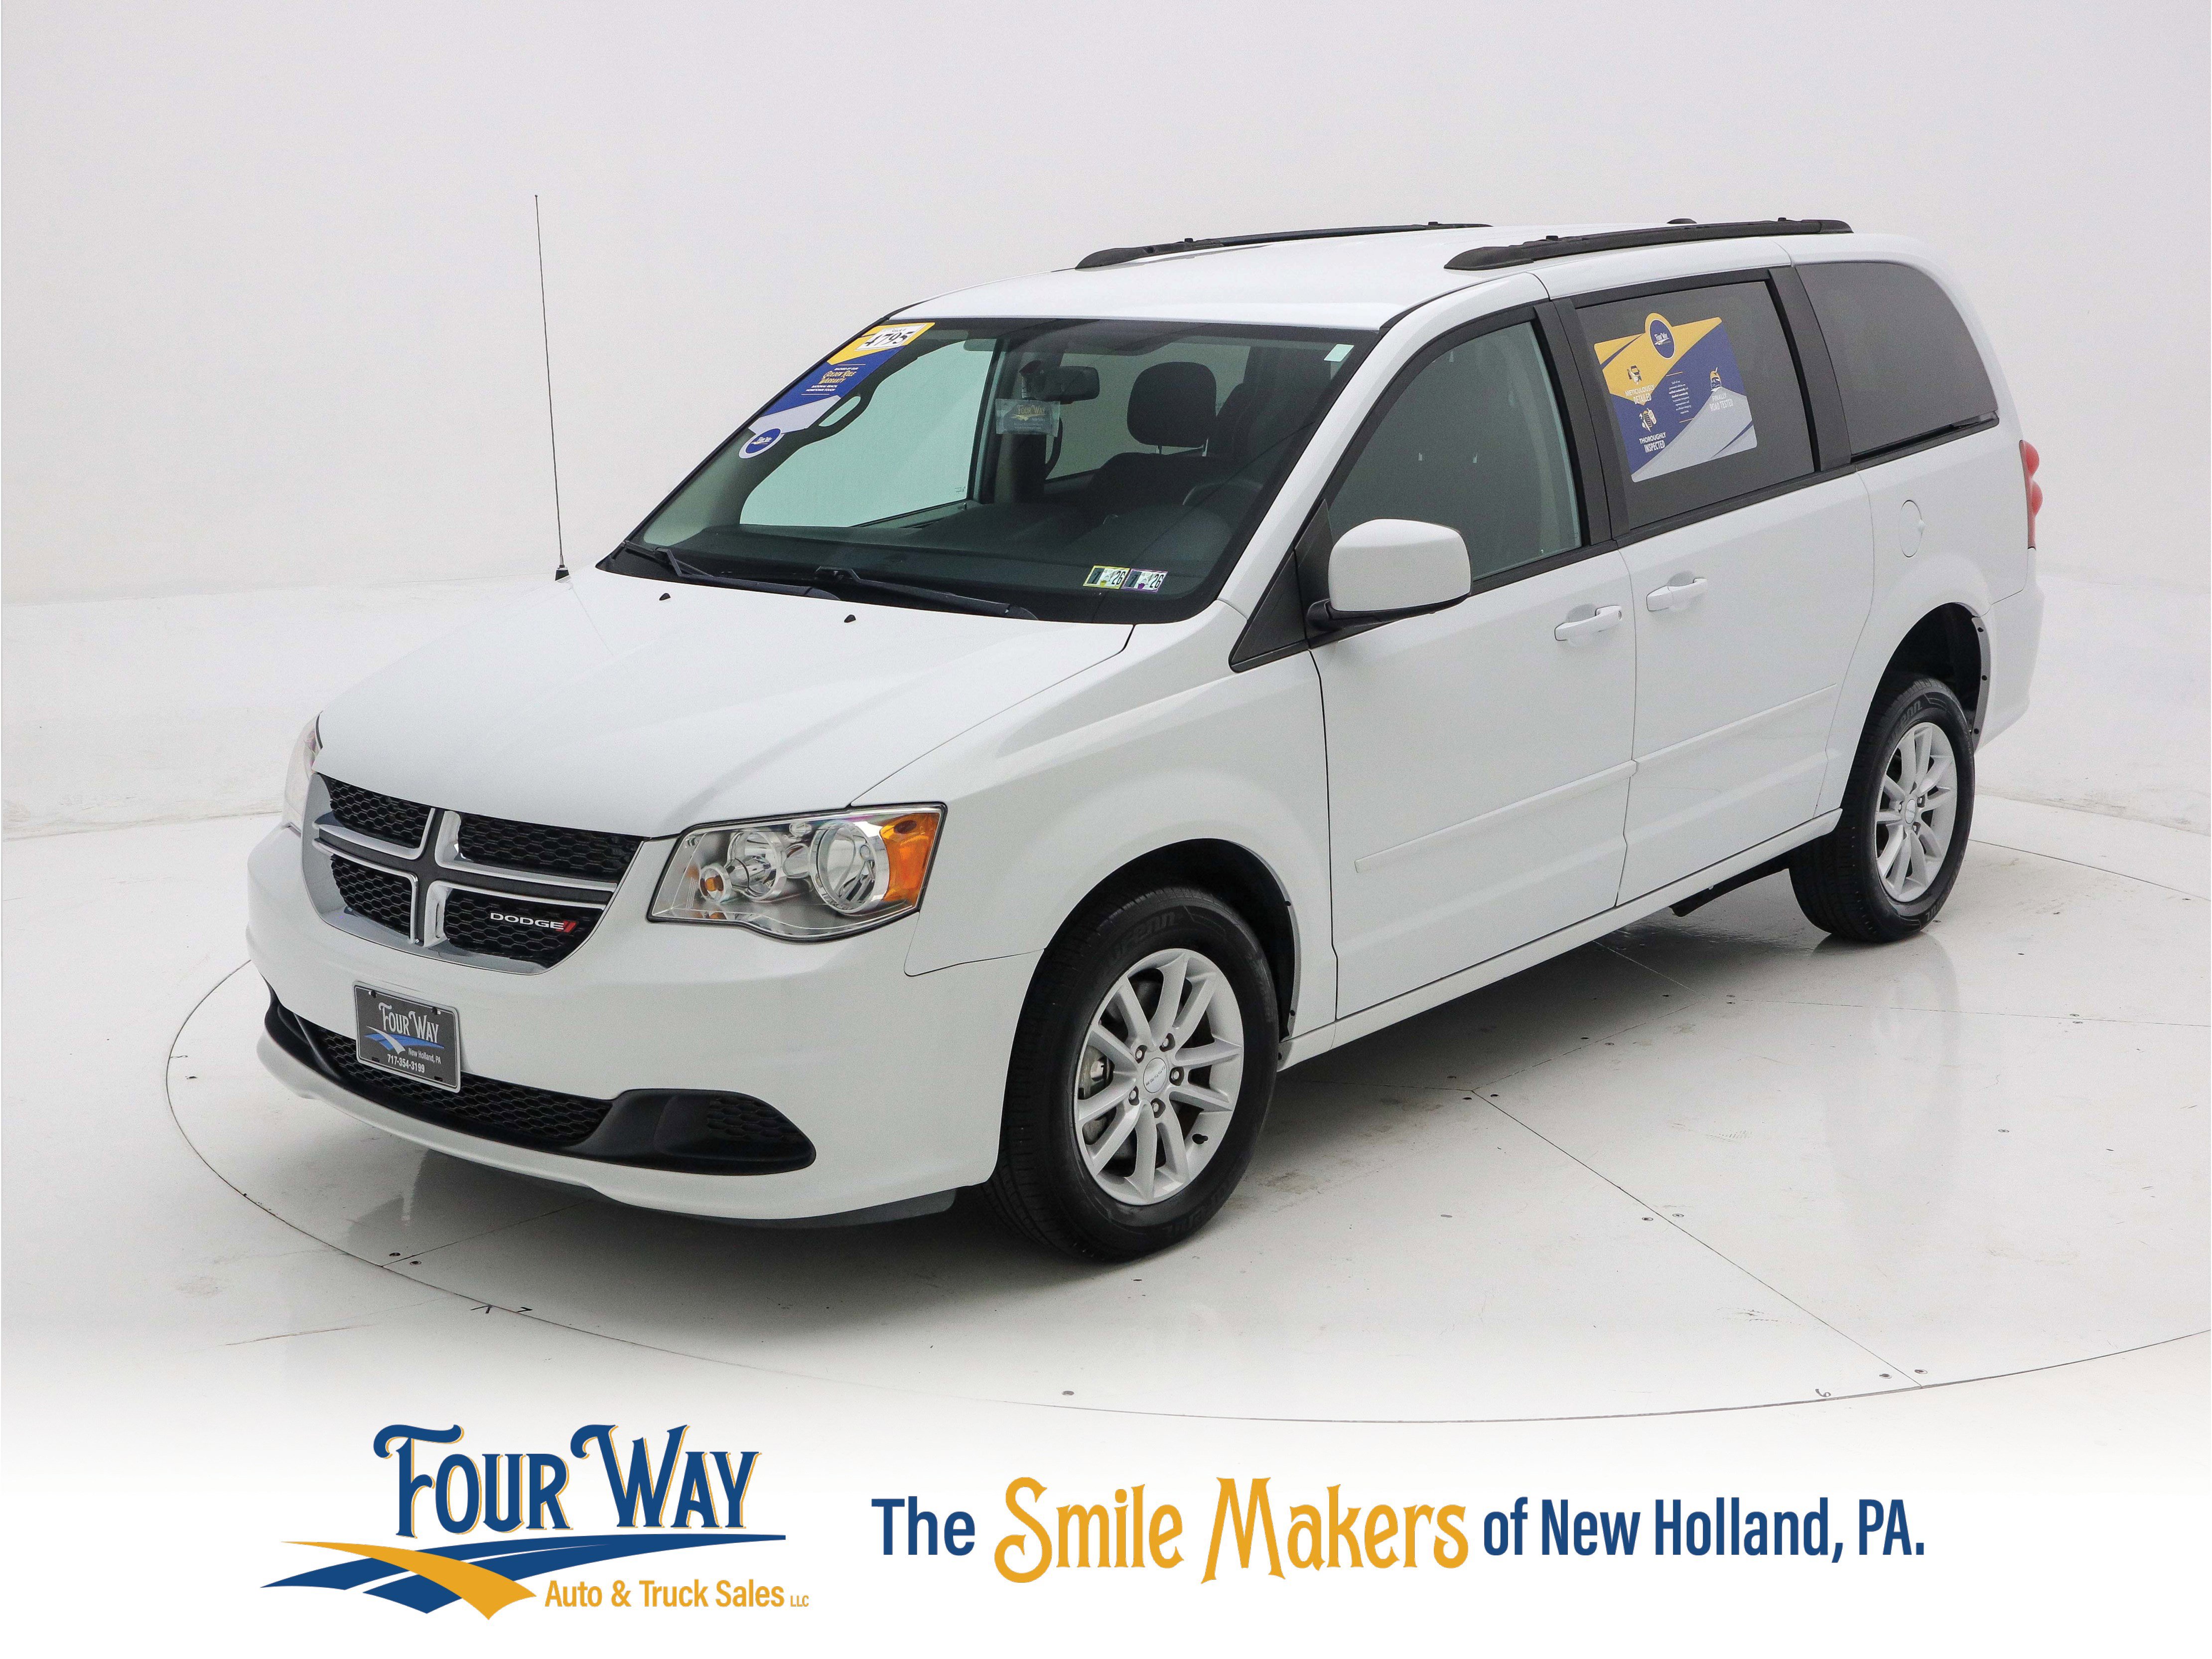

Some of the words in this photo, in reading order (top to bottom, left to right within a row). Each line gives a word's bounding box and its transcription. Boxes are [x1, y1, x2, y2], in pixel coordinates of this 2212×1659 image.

[1625, 384, 1655, 397] METICULOUSLY
[1633, 393, 1652, 405] DETAILED
[1639, 431, 1666, 444] THOROUGHLY
[1644, 439, 1665, 453] INSPECTED
[1111, 570, 1126, 585] 26
[1149, 573, 1164, 588] 26
[490, 912, 564, 930] DODGE
[378, 1002, 411, 1036] FOUR
[408, 1010, 439, 1044] WAY
[387, 1053, 425, 1074] 717-354-3199
[408, 1047, 418, 1057] New
[418, 1051, 435, 1062] Holland,
[435, 1056, 441, 1065] PA
